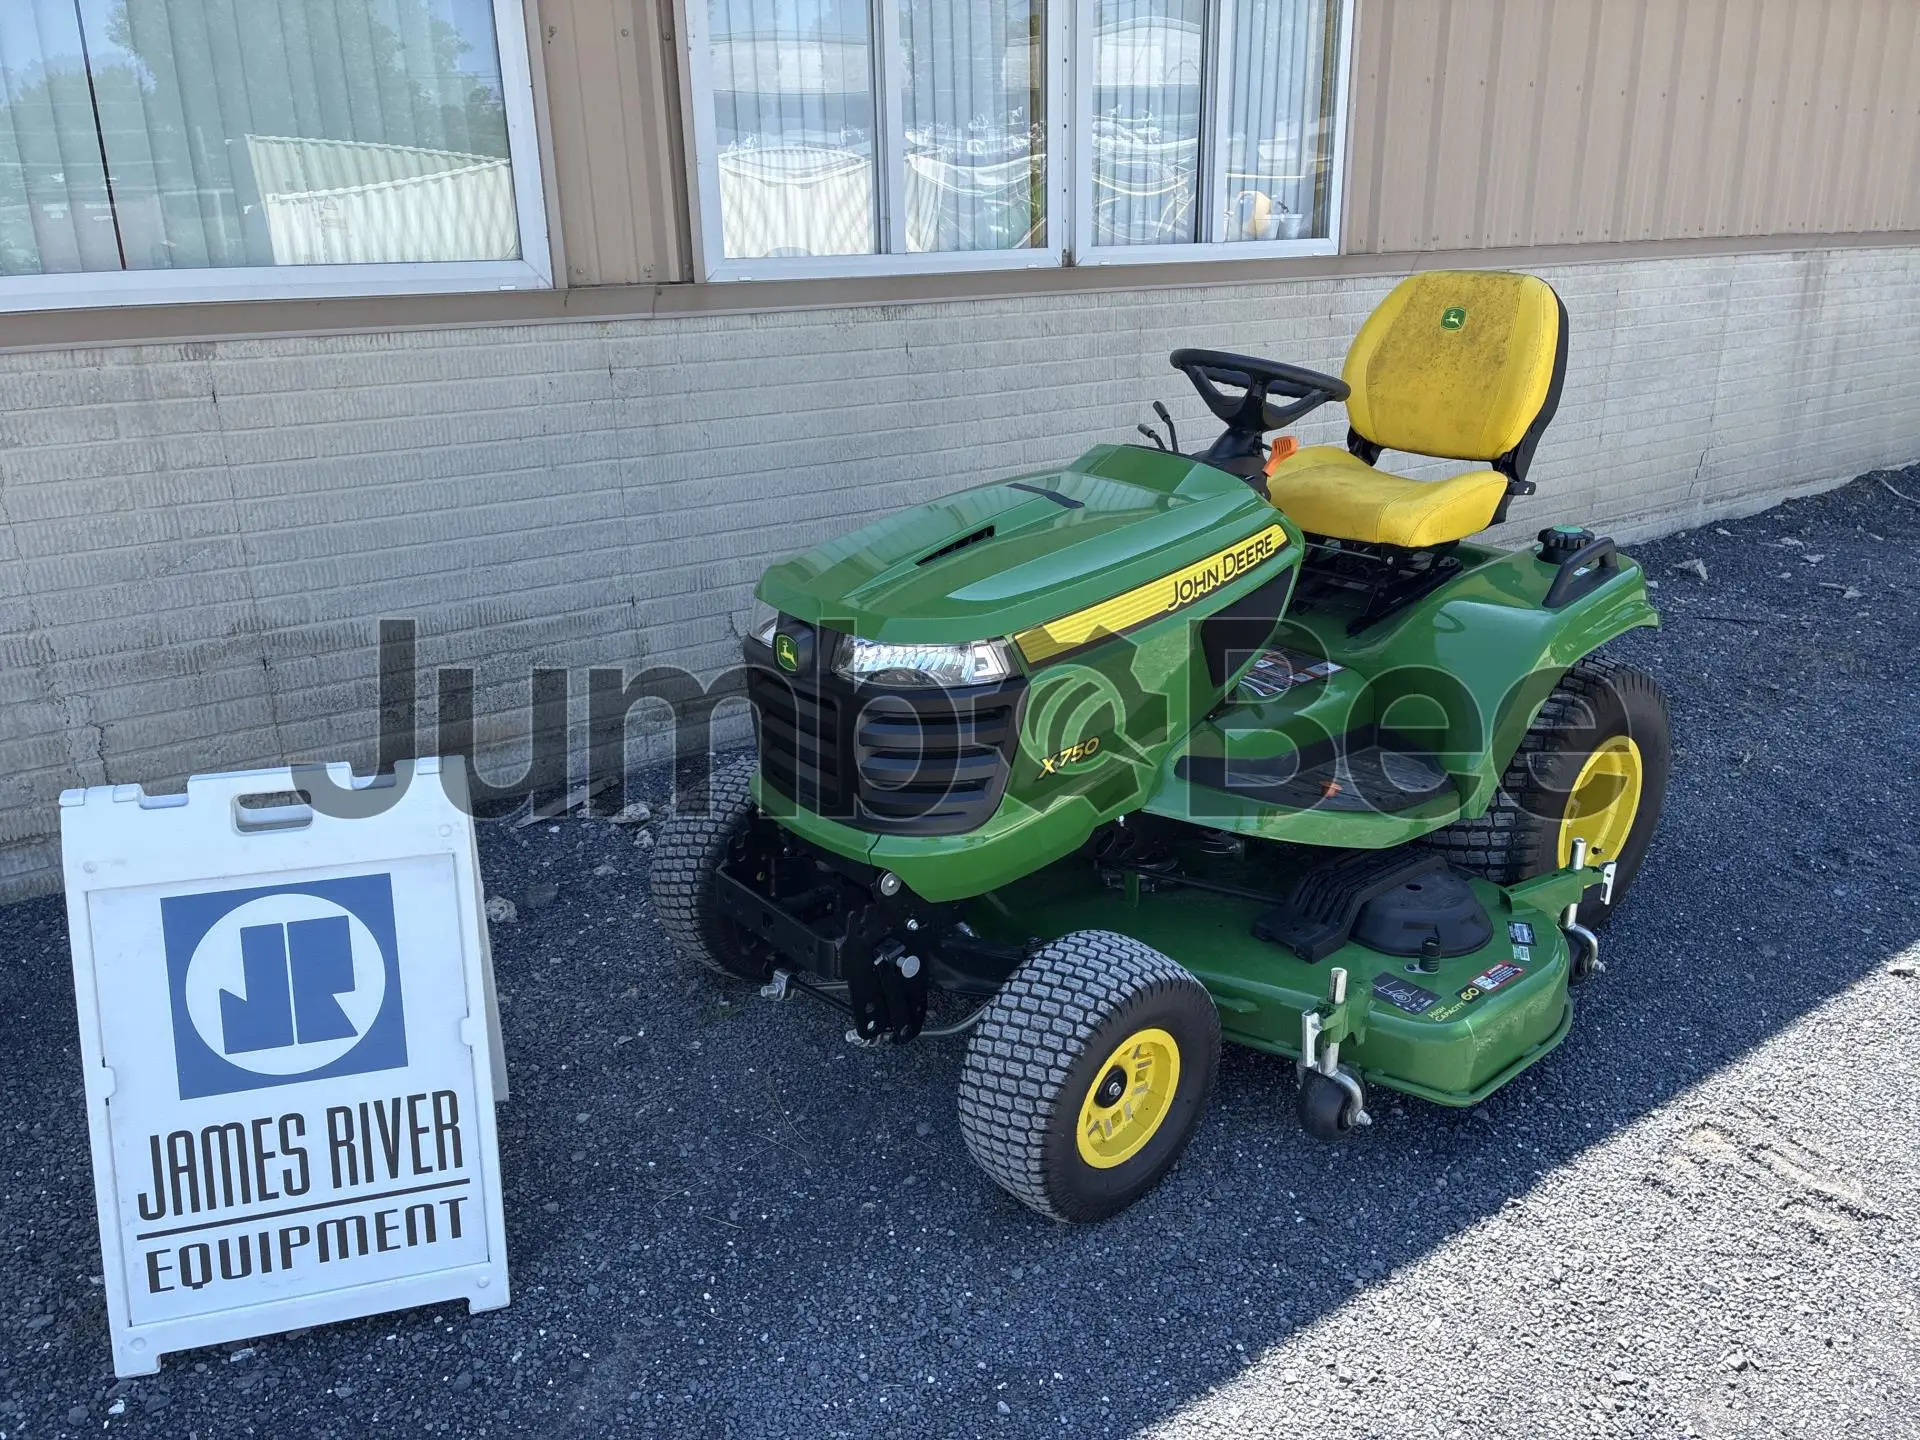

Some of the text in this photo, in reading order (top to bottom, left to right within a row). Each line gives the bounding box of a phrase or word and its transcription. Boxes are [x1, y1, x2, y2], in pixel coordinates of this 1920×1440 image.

[1168, 533, 1274, 610] JOHN DEERE
[1037, 736, 1101, 781] X750
[1435, 1000, 1466, 1022] CAPACITY
[1460, 987, 1480, 1001] 60
[137, 1089, 464, 1222] JAMES RIVER
[145, 1196, 469, 1294] EQUIPMENT
